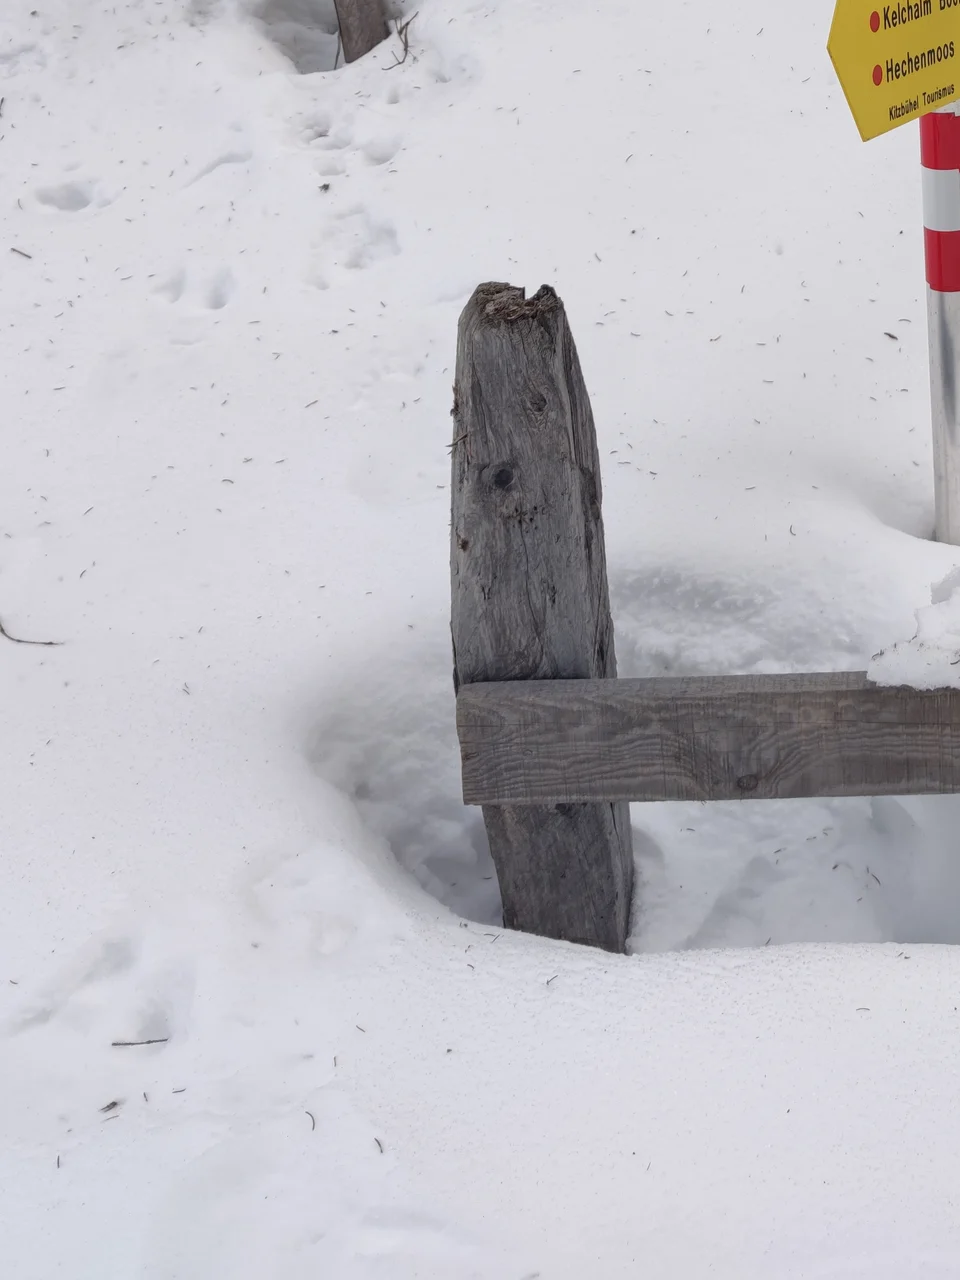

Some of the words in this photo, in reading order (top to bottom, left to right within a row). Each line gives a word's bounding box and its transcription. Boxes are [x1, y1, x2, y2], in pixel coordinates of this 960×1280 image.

[886, 41, 954, 84] Hechenmoos
[889, 96, 919, 121] Kitzbühel
[922, 84, 954, 105] Tourismus
